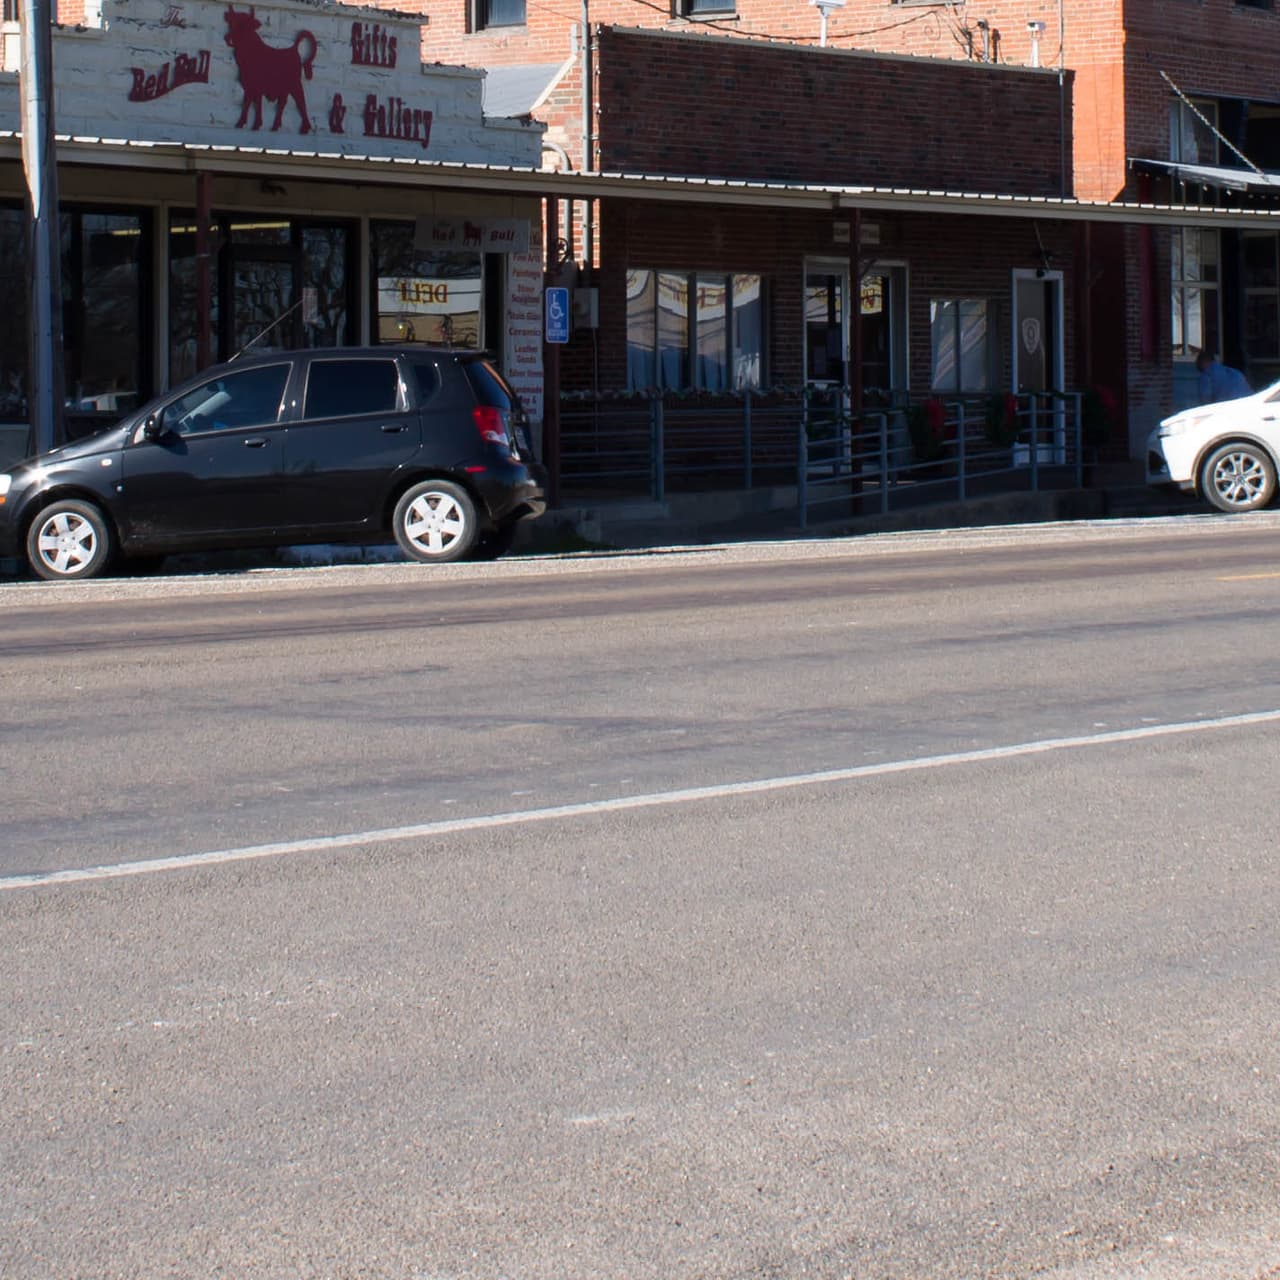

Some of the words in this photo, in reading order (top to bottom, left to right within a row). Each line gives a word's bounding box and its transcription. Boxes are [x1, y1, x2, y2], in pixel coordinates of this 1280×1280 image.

[160, 5, 187, 29] The
[349, 21, 398, 69] Gifts
[128, 64, 170, 103] Red
[170, 49, 212, 89] Bull
[328, 93, 346, 134] &
[362, 94, 434, 149] Gallery
